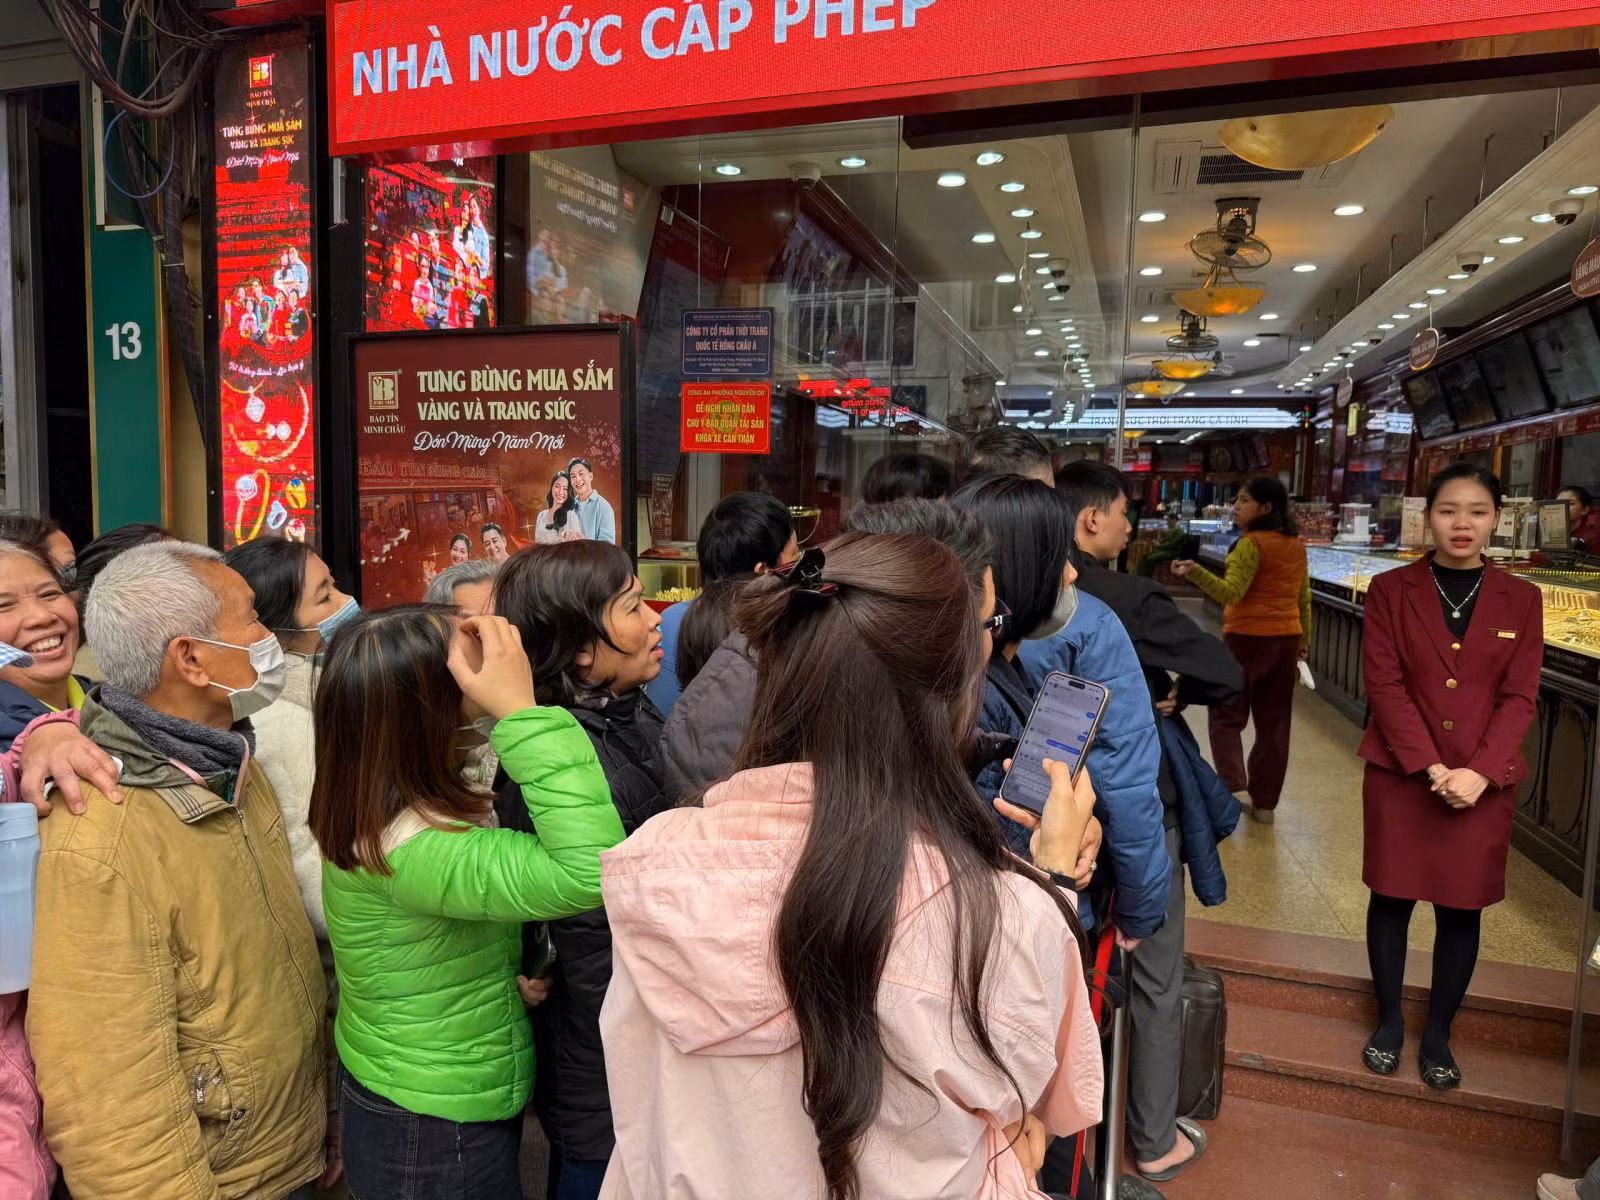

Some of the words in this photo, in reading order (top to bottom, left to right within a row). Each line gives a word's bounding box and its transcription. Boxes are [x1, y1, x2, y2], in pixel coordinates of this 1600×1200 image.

[353, 25, 453, 96] NHÀ
[469, 5, 622, 81] NƯỚC
[105, 321, 142, 361] 13
[416, 369, 466, 393] TƯNG
[470, 364, 522, 392] BỪNG
[526, 368, 569, 391] MUA
[572, 359, 614, 391] SẮM
[386, 413, 399, 422] TÍN
[416, 398, 460, 421] VÀNG
[462, 397, 485, 420] VÀ
[487, 401, 541, 420] TRANG
[544, 396, 576, 420] SỨC
[363, 425, 384, 434] MINH
[384, 424, 406, 433] CHÂU
[413, 430, 447, 451] Đón
[446, 431, 492, 456] Mừng
[491, 431, 532, 453] Năm
[529, 431, 566, 454] Mới
